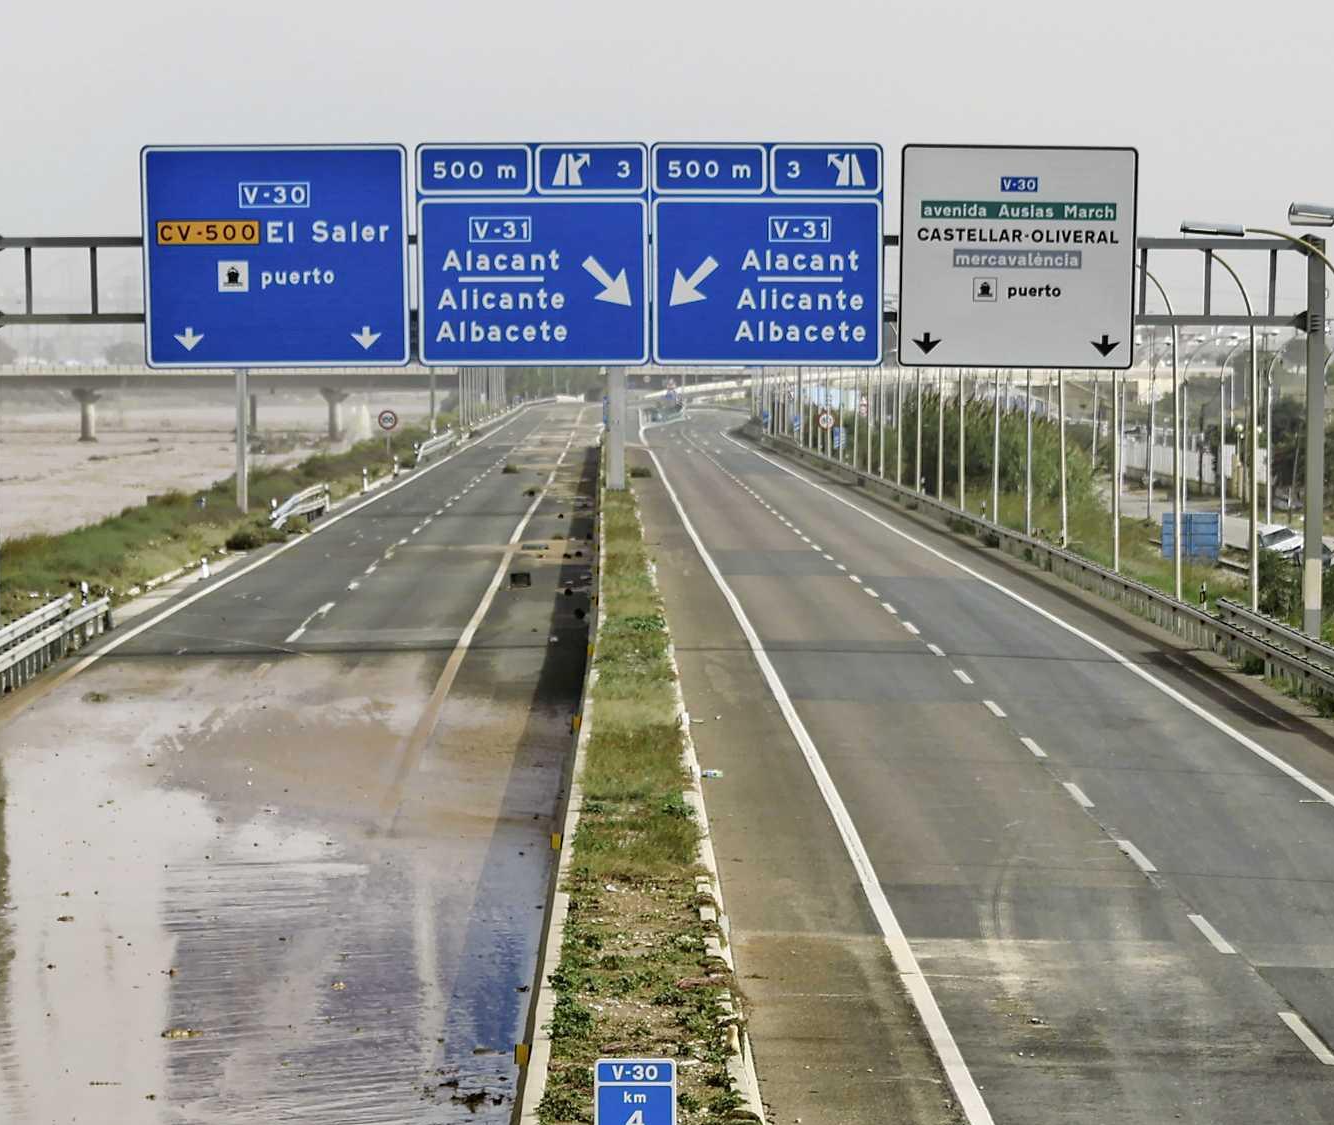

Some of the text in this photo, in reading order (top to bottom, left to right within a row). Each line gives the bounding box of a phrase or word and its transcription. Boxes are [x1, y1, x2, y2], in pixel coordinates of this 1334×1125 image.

[433, 161, 517, 179] 500 m
[617, 161, 631, 178] 3
[668, 161, 751, 179] 500 m
[786, 161, 800, 178] 3
[1003, 178, 1036, 191] V-30
[243, 186, 306, 204] V-30
[923, 203, 1115, 219] avenida Ausias March
[160, 220, 390, 243] CV-500 El Saler
[474, 221, 529, 239] V-31
[774, 221, 828, 239] V-31
[917, 227, 1119, 244] CASTELLAR-OLIVERAL
[442, 249, 560, 271] Alacant
[741, 249, 859, 271] Alacant
[261, 267, 335, 290] puerto
[437, 288, 565, 310] Alicante
[736, 288, 864, 311] Alicante
[1007, 284, 1061, 299] puerto
[436, 320, 568, 342] Albacete
[734, 320, 866, 342] Albacete
[611, 1064, 659, 1081] V-30
[623, 1090, 647, 1104] km
